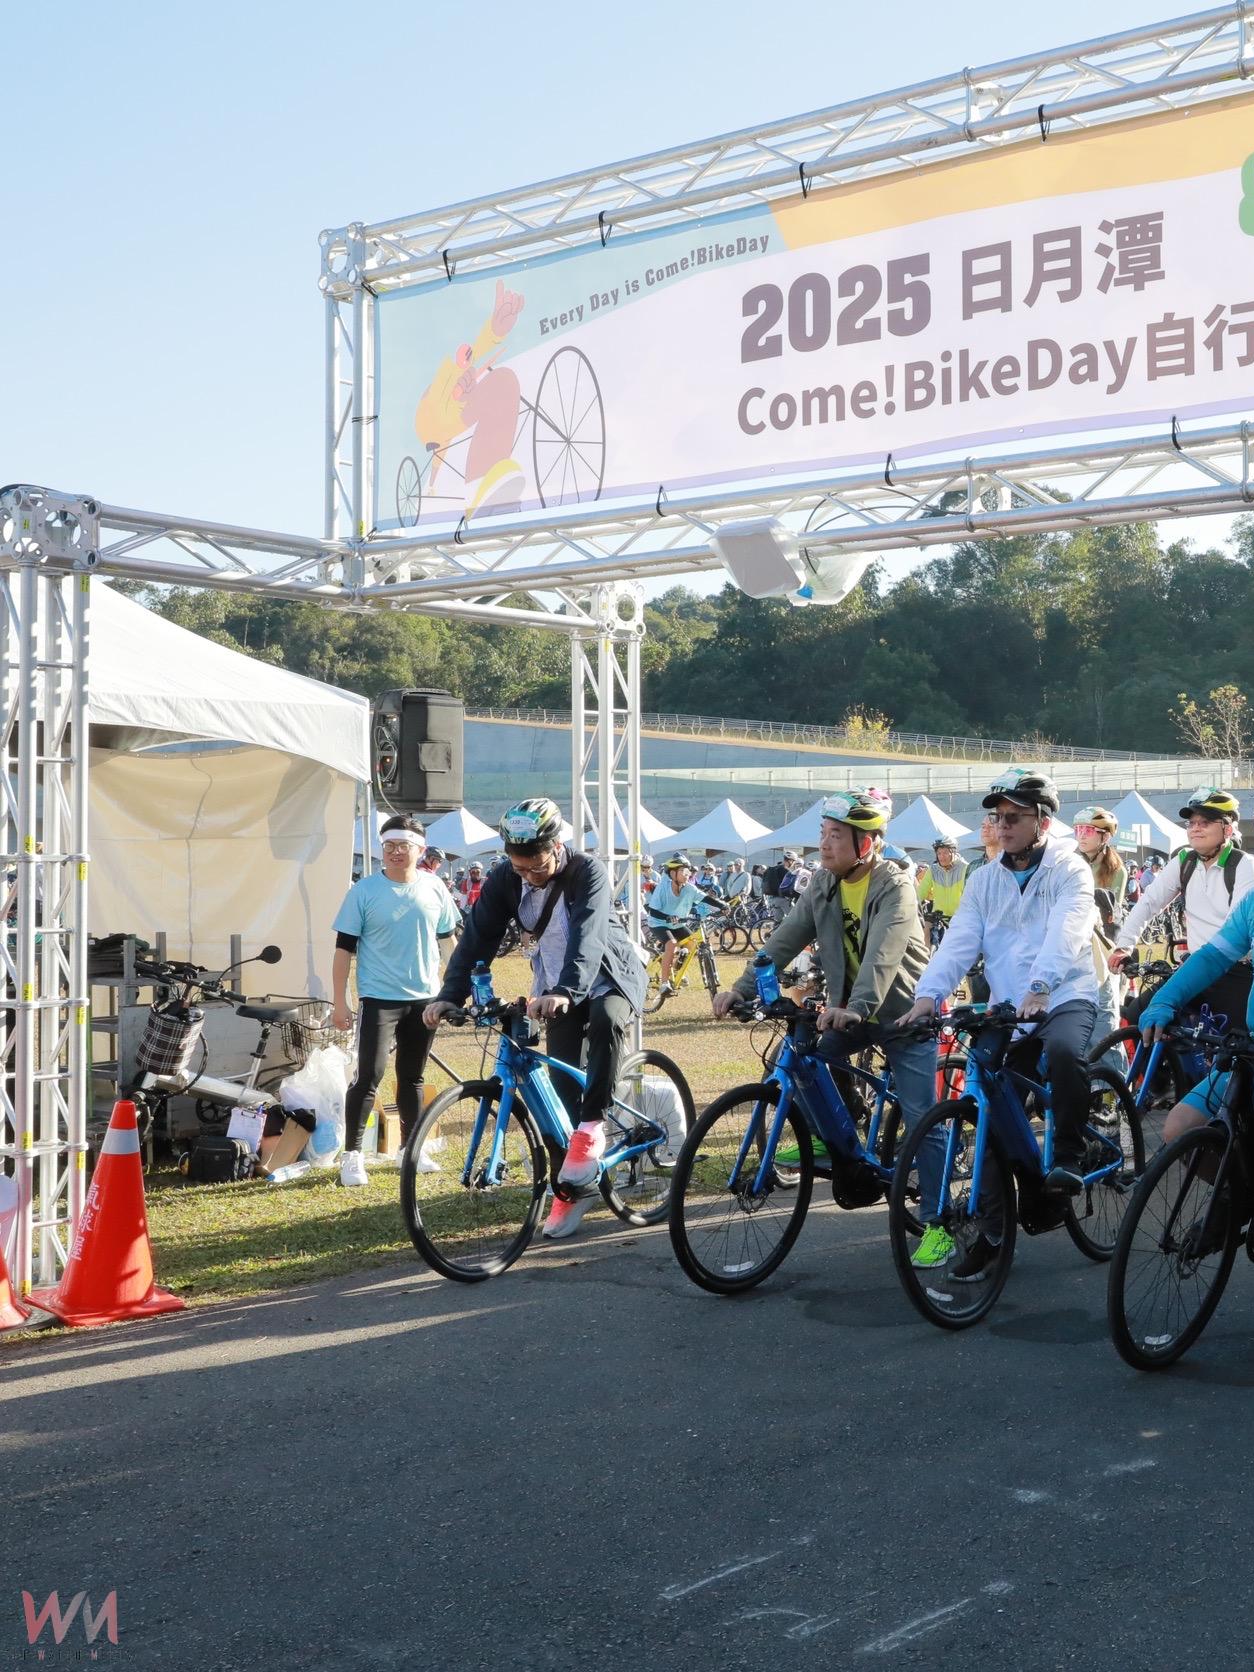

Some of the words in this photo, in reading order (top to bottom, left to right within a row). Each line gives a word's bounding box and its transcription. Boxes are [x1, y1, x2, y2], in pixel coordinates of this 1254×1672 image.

[539, 304, 584, 335] Every
[589, 287, 619, 312] Day
[624, 279, 640, 296] is
[645, 234, 770, 287] Come!BikeDay
[740, 252, 932, 364] 2025
[961, 211, 1166, 321] 日月潭
